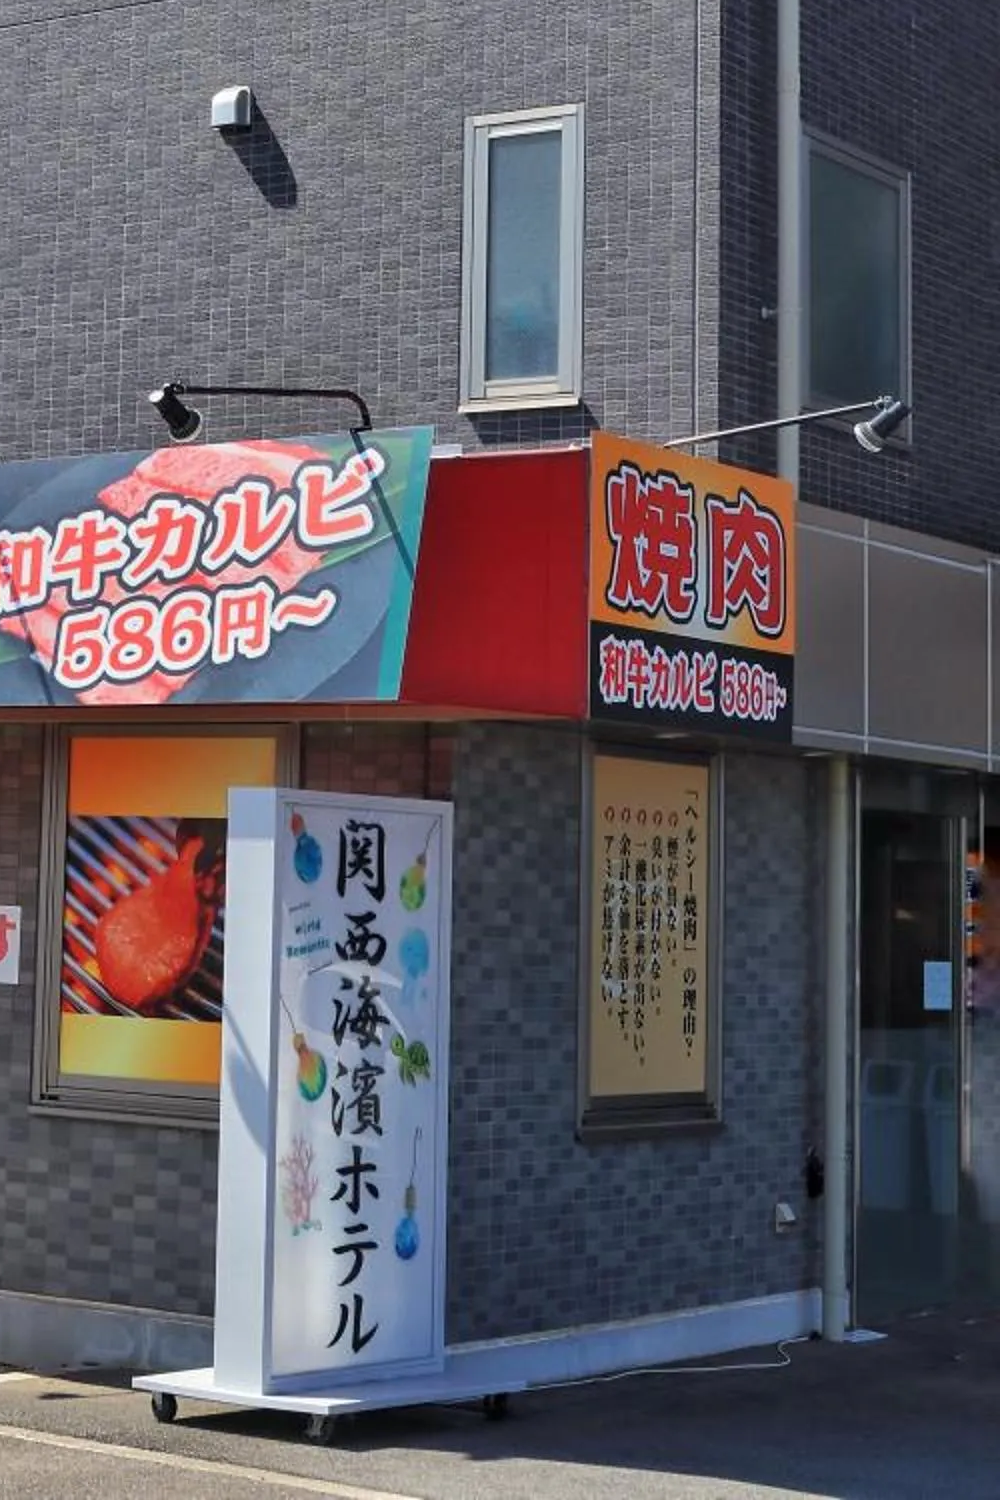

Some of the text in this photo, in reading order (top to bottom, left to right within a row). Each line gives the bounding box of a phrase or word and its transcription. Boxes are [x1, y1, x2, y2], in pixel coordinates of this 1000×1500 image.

[604, 462, 786, 636] 焼肉
[600, 634, 717, 712] 和牛カルビ
[328, 819, 391, 1354] 関西海濱ホテル
